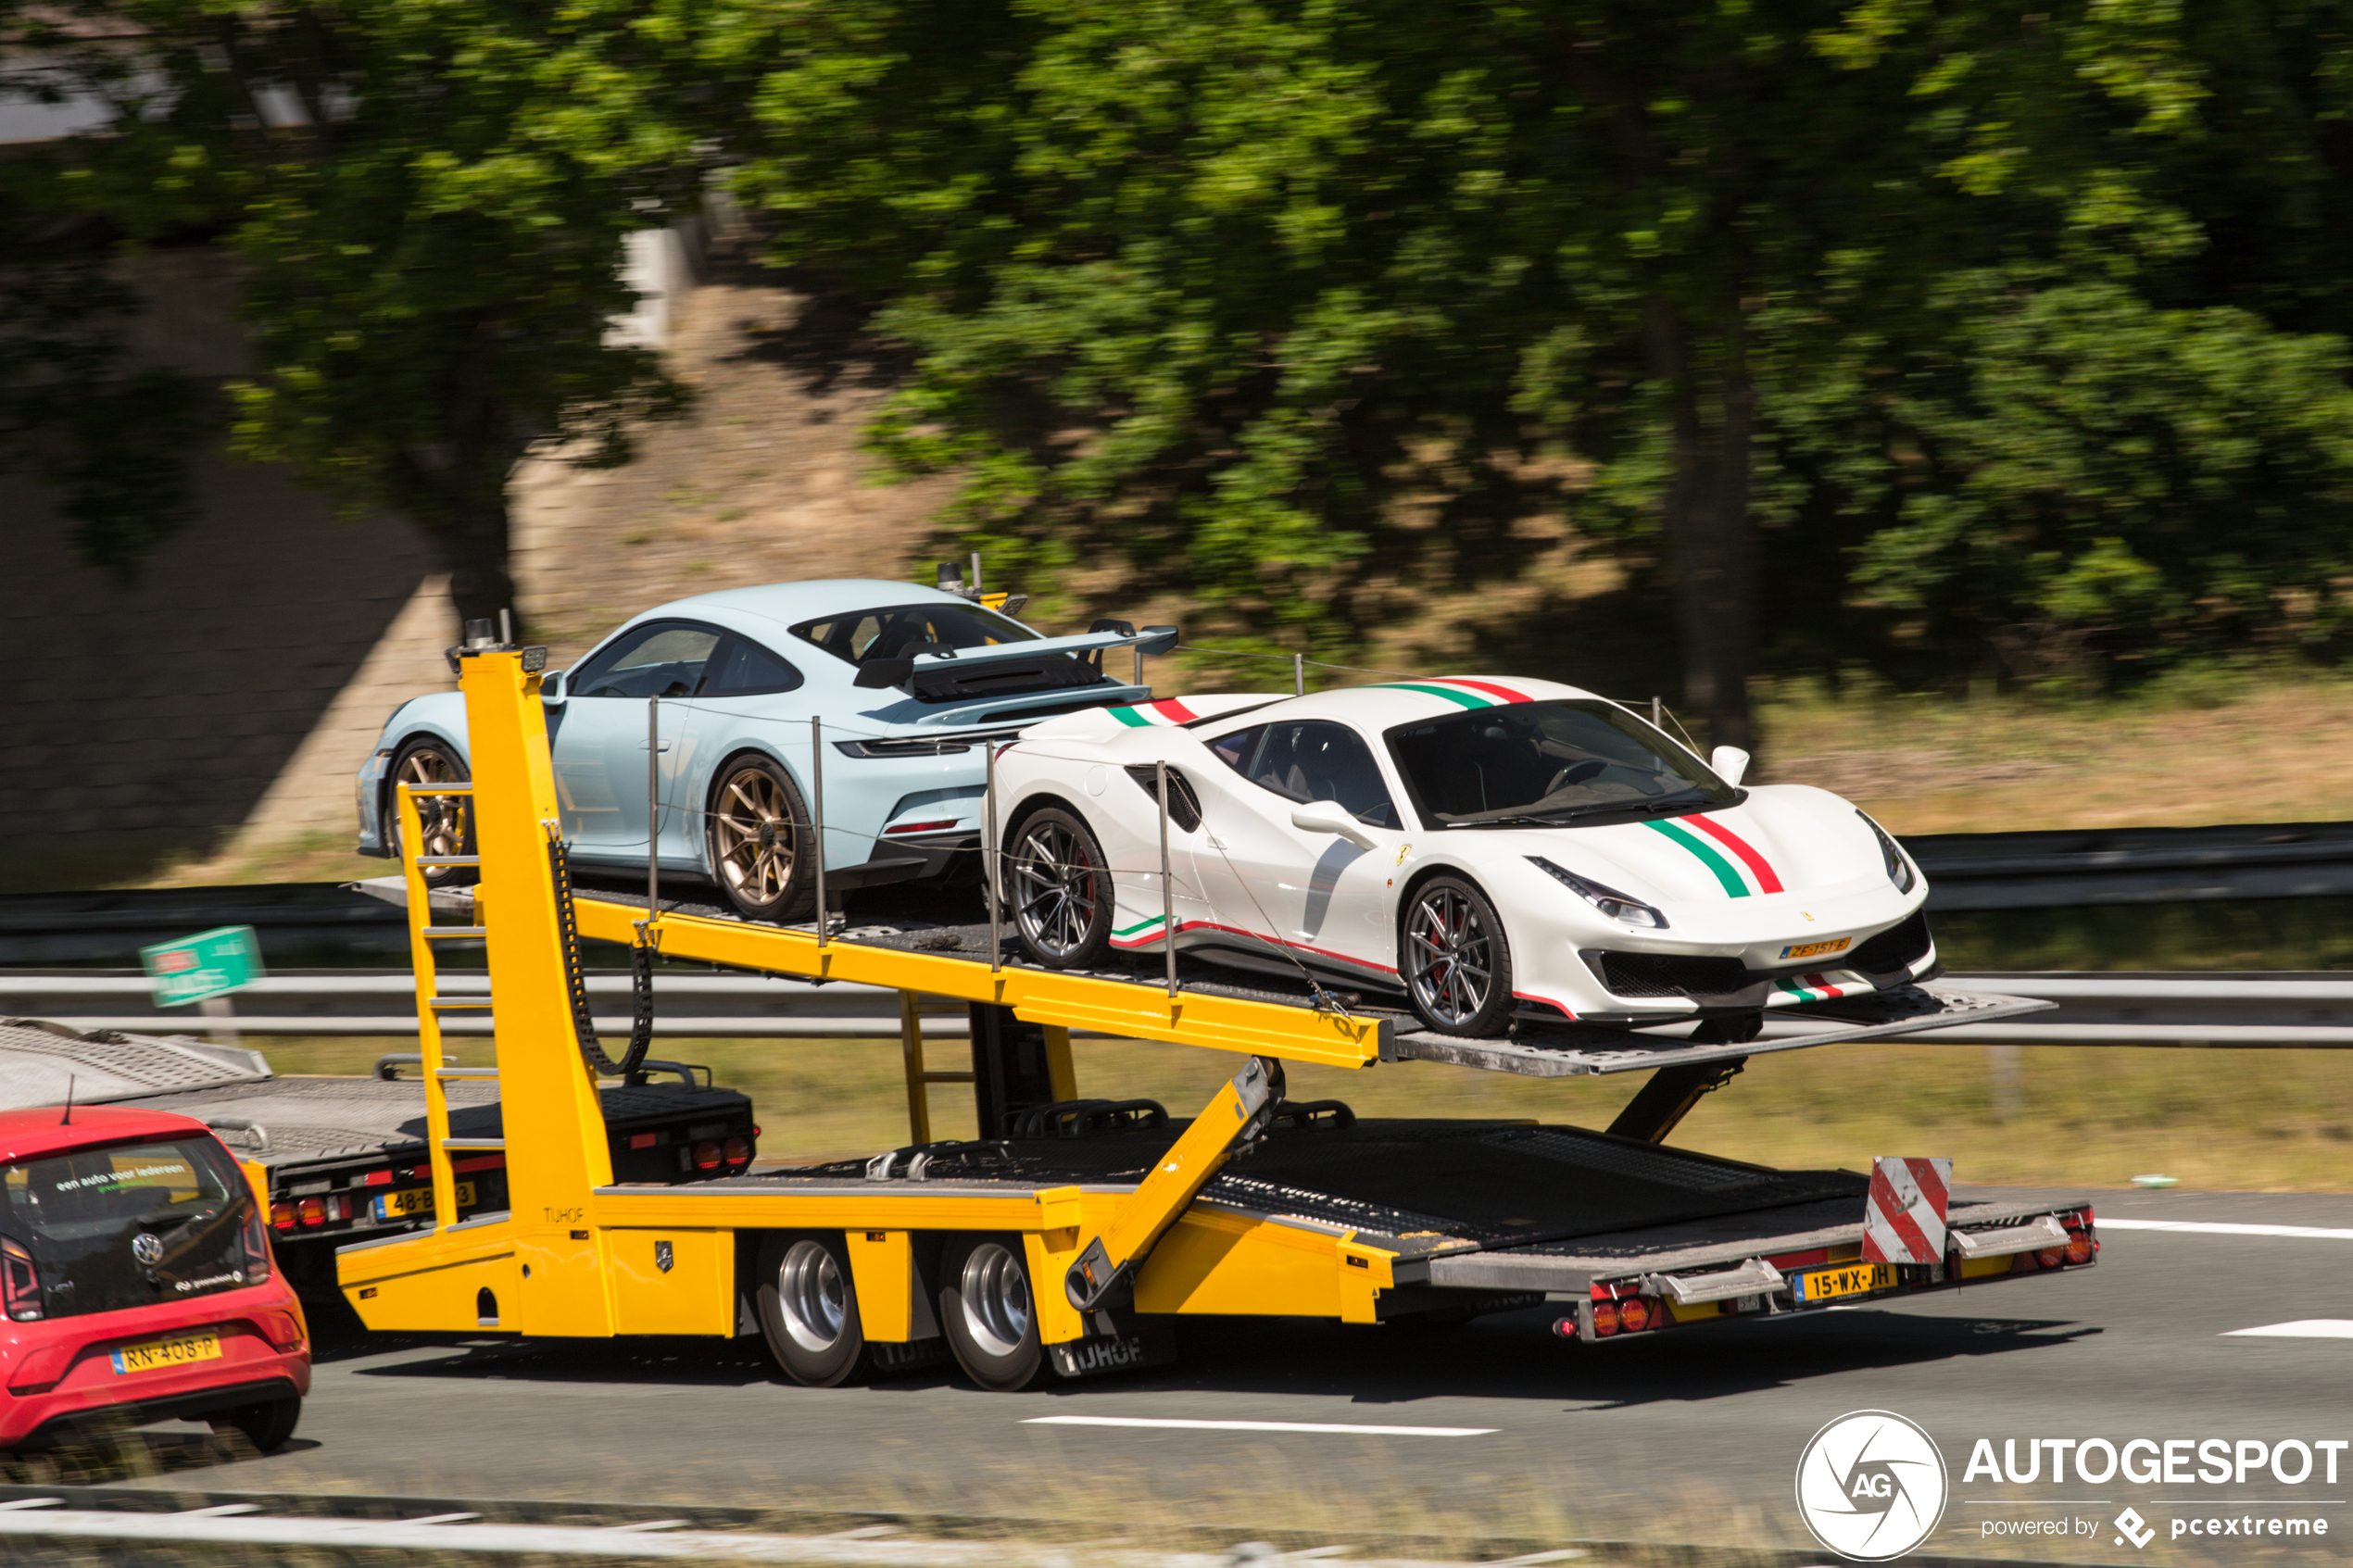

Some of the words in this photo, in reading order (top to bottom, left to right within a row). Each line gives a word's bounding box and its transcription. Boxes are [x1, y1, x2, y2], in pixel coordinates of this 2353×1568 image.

[1791, 939, 1846, 957] ZF-151-F
[56, 1179, 81, 1192] een
[80, 1173, 109, 1187] auto
[107, 1169, 136, 1182] voor
[1813, 1265, 1889, 1297] 15-WX-JH
[125, 1336, 213, 1369] RN-408-P
